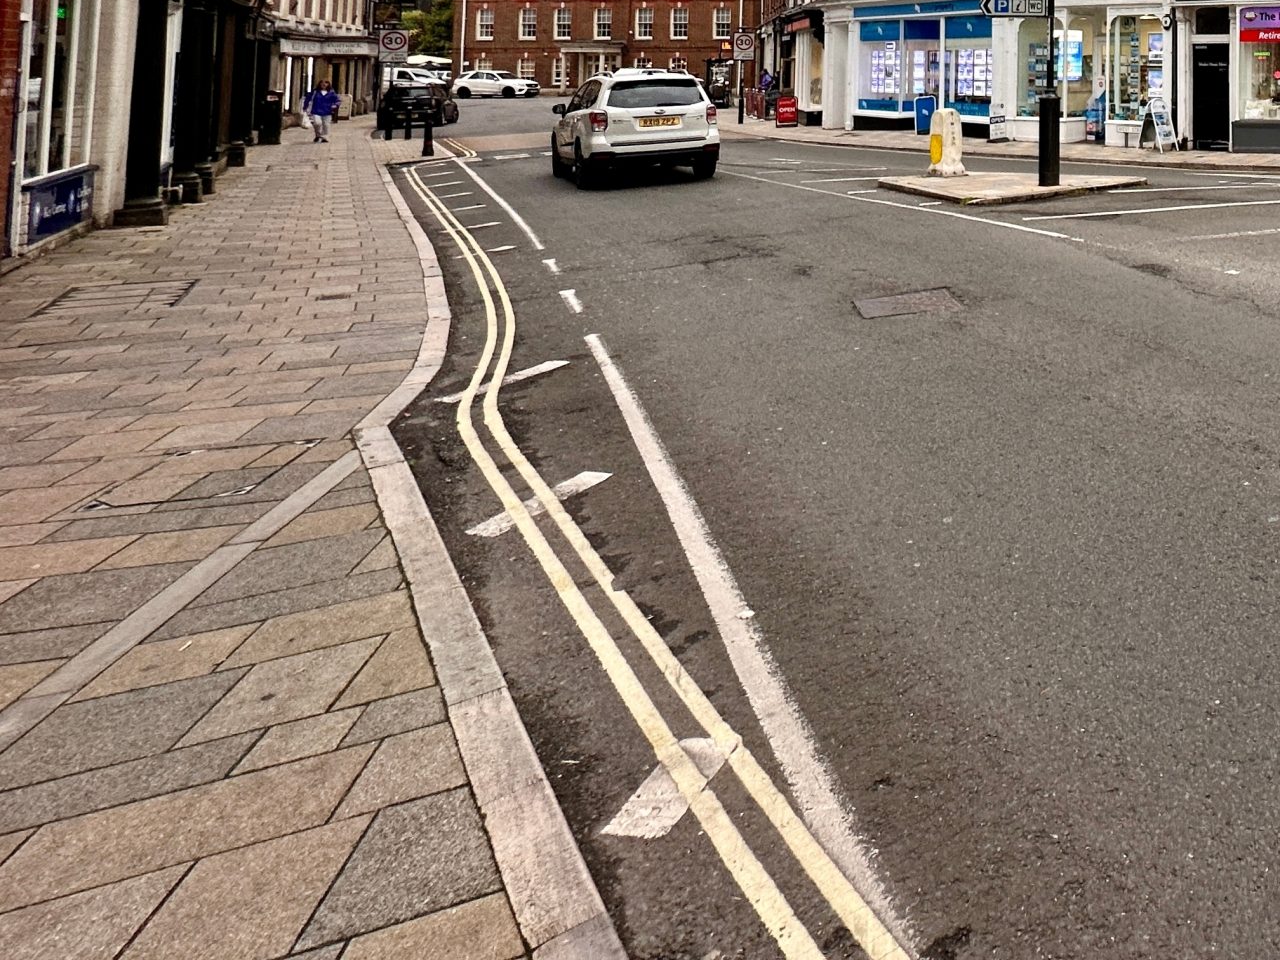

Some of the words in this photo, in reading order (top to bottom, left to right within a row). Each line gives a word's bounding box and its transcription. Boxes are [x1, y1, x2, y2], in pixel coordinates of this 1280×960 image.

[998, 0, 1007, 12] P
[1030, 2, 1042, 10] WC
[1259, 12, 1276, 20] The
[385, 37, 403, 45] 30
[990, 116, 1005, 124] OPEN
